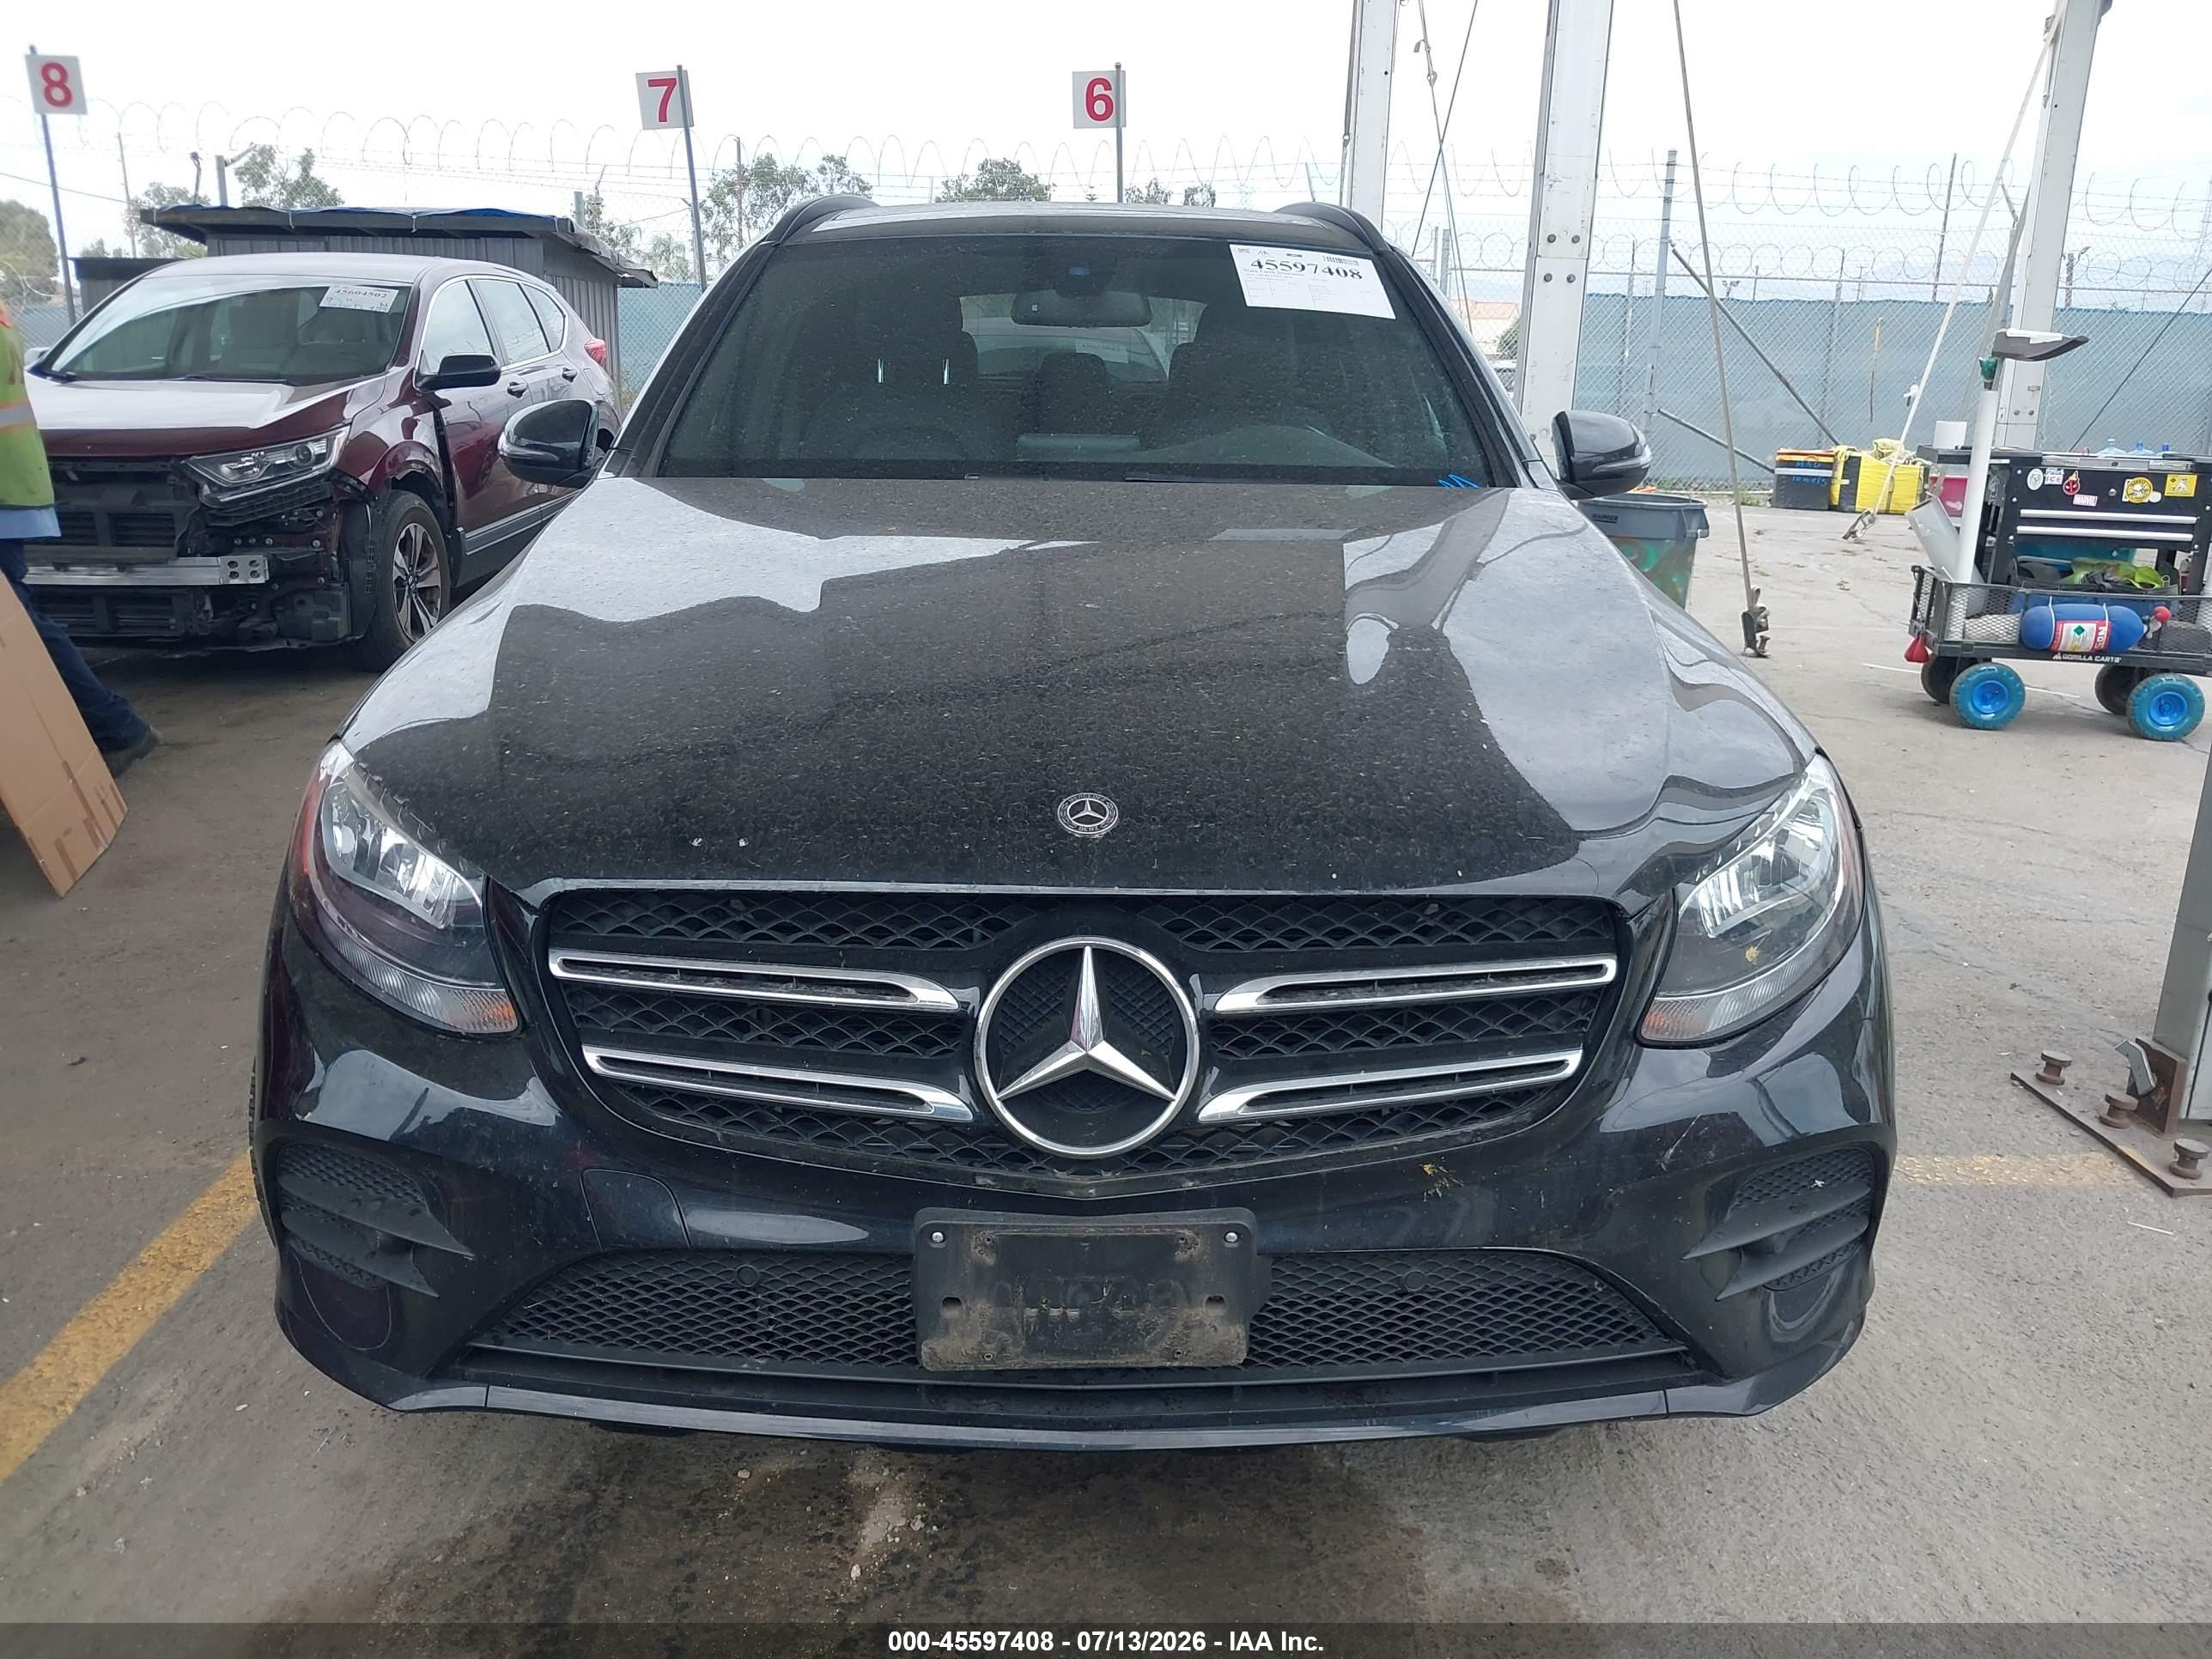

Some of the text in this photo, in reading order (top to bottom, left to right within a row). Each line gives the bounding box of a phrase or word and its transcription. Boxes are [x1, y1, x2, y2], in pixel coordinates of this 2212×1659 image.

[40, 62, 73, 108] 8
[647, 78, 678, 123] 7
[1085, 77, 1115, 122] 6
[1250, 258, 1363, 280] 45597408
